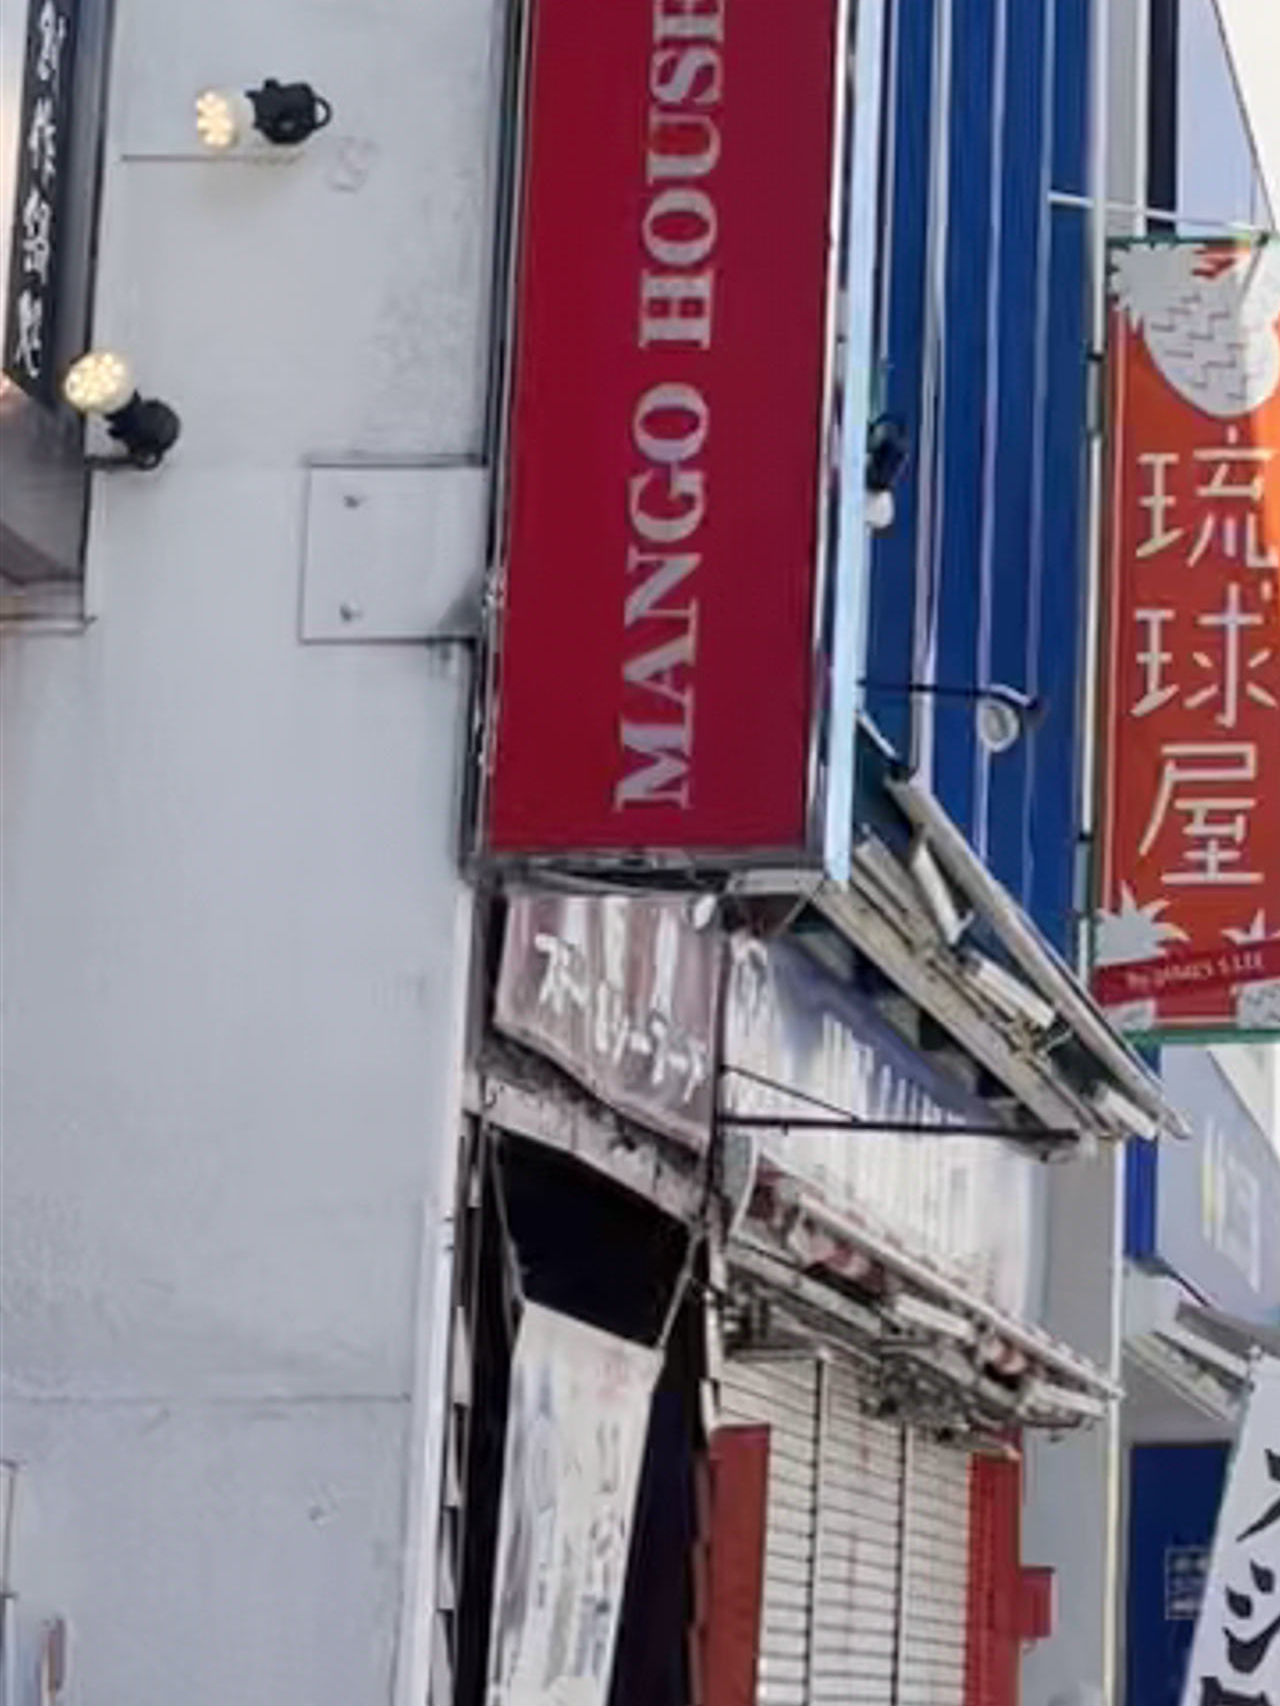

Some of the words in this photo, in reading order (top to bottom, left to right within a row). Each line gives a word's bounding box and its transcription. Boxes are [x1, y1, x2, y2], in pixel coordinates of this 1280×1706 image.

[614, 382, 712, 813] MANGO
[1131, 425, 1280, 886] 琉球屋
